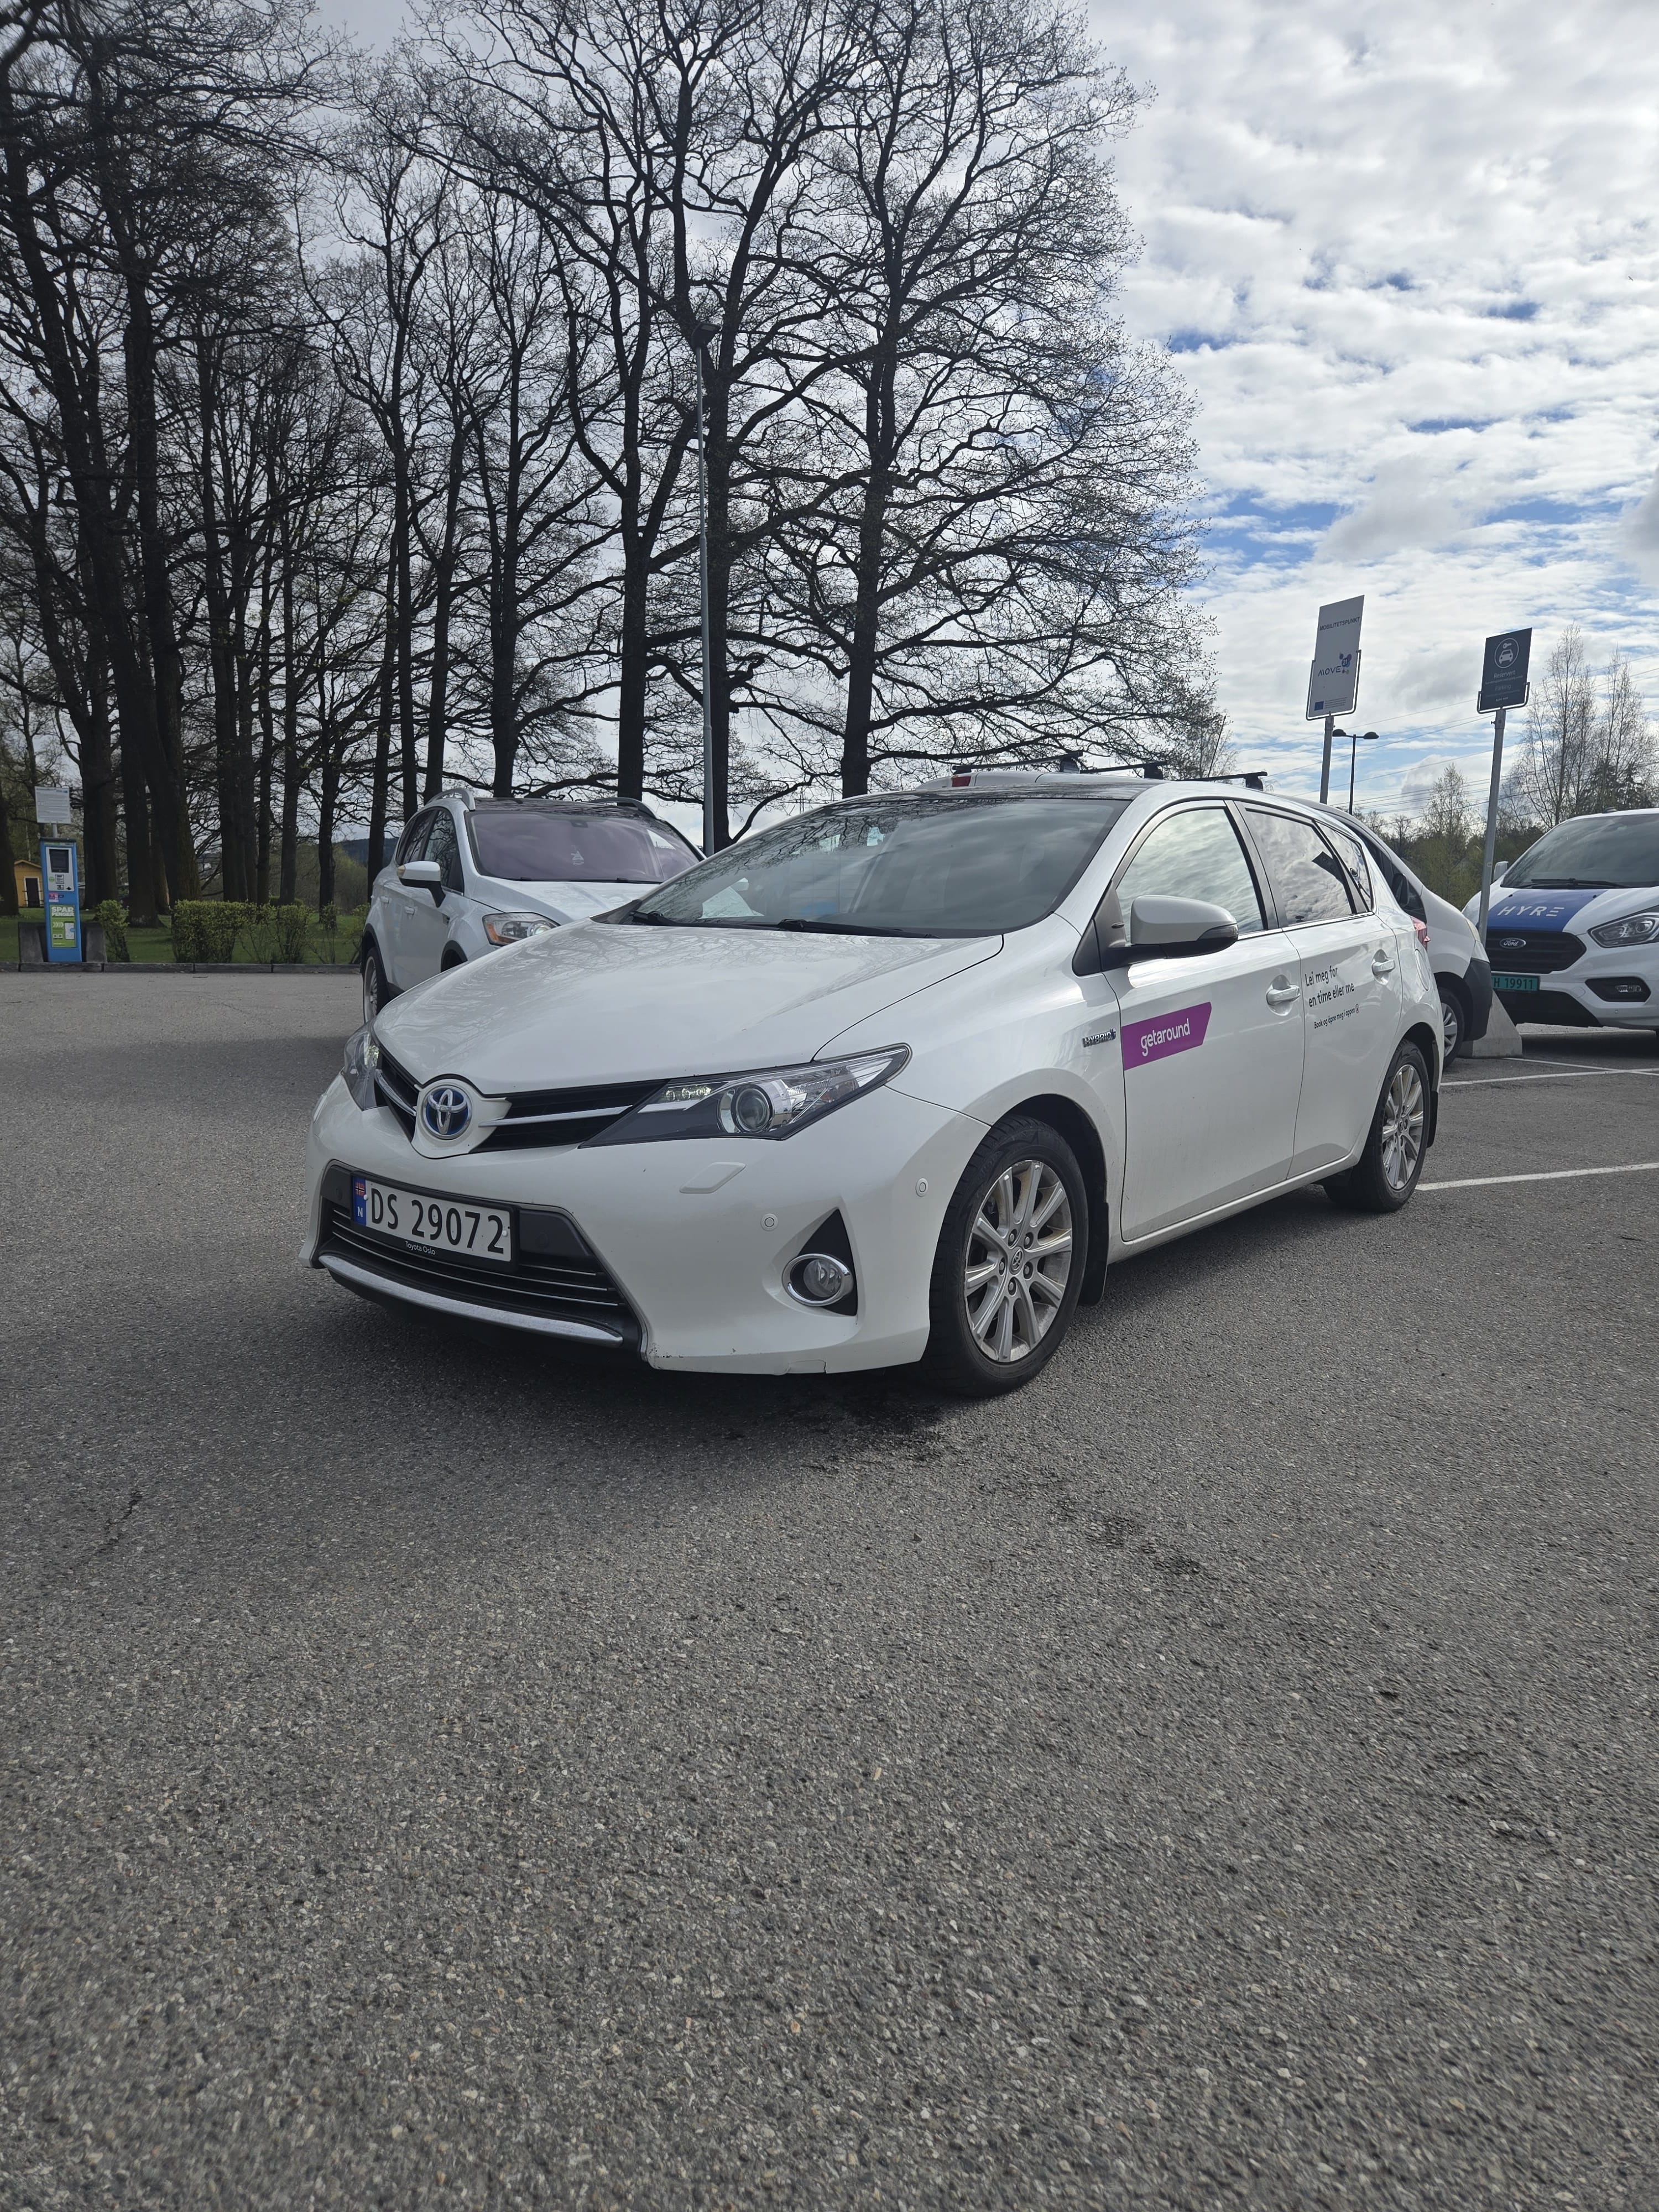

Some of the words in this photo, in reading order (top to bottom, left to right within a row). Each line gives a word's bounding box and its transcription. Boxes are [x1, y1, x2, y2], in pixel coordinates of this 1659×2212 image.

[1319, 617, 1360, 630] MOBILITETSPUNKT
[1318, 666, 1341, 676] MOVE
[1497, 906, 1564, 916] HYRE
[1305, 971, 1314, 987] Lei
[1316, 971, 1329, 984] meg
[1329, 966, 1338, 978] for
[1505, 978, 1533, 989] 19911
[1308, 997, 1317, 1008] en
[1317, 990, 1332, 1004] time
[1333, 985, 1344, 998] eller
[1314, 1019, 1323, 1029] Book
[1345, 1008, 1355, 1018] appen
[1084, 1031, 1113, 1047] HYBRID
[1141, 1018, 1191, 1057] getaround
[357, 1206, 363, 1218] N
[371, 1188, 399, 1229] DS
[411, 1199, 504, 1254] 29072
[405, 1240, 422, 1252] Toyota
[422, 1246, 436, 1255] Oslo
